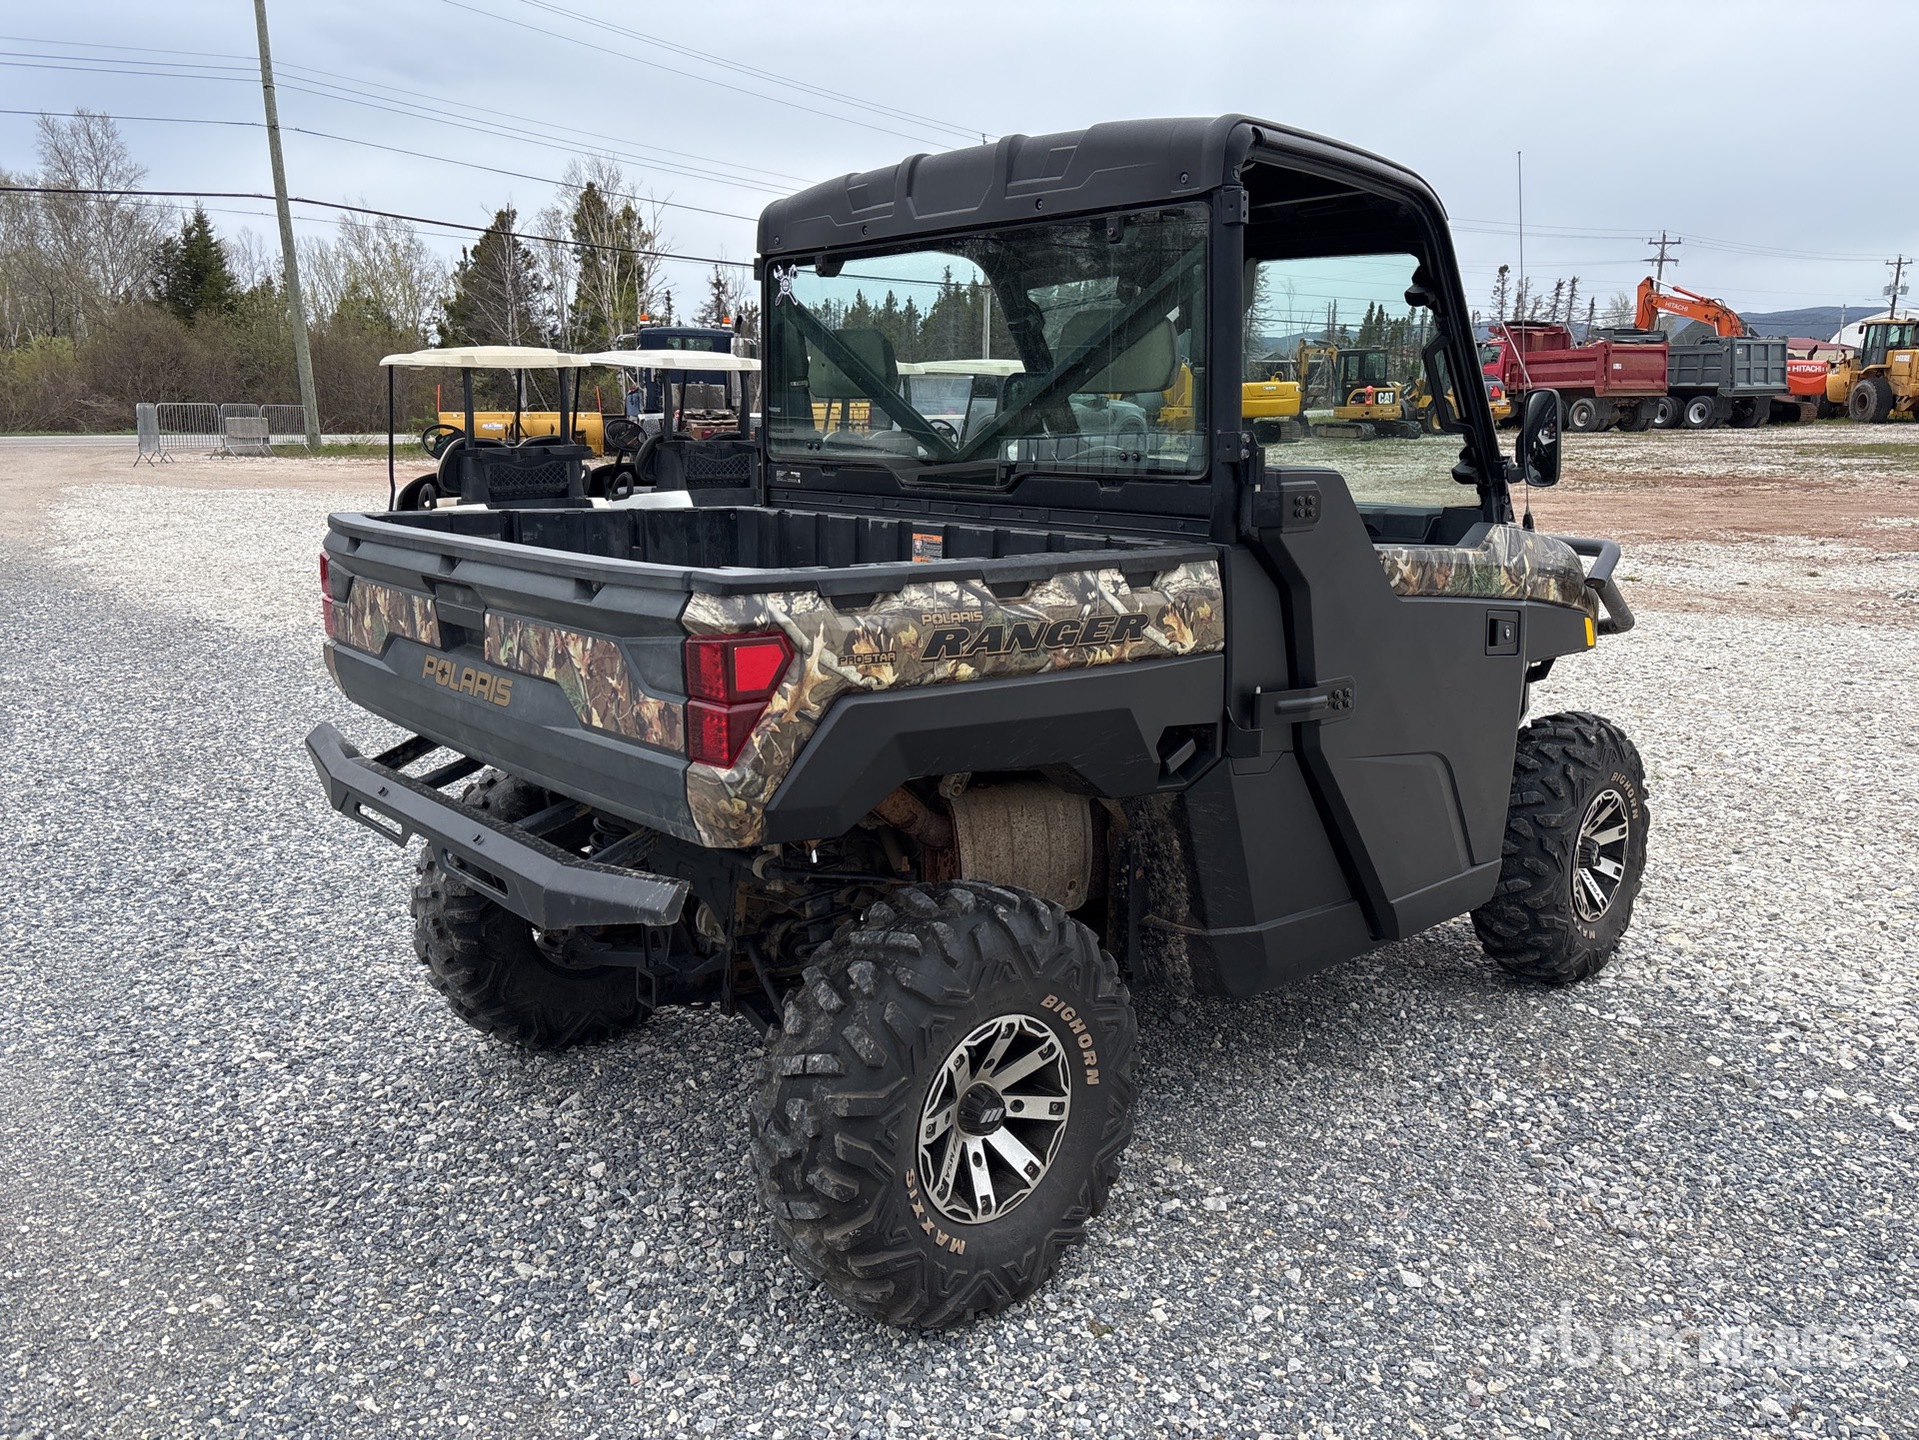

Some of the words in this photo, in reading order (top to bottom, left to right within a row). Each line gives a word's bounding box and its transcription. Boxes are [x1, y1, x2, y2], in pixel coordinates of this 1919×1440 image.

[1665, 301, 1689, 312] HITACHI
[1792, 364, 1822, 373] HITACHI
[1378, 392, 1394, 404] CAT
[921, 611, 984, 626] POLARIS
[919, 612, 1150, 662] RANGER
[838, 651, 897, 666] PROSTAR
[422, 654, 513, 707] POLARIS
[1610, 771, 1639, 820] BIGHORN
[1040, 993, 1100, 1085] BIGHORN
[905, 1168, 967, 1256] MAXXIS
